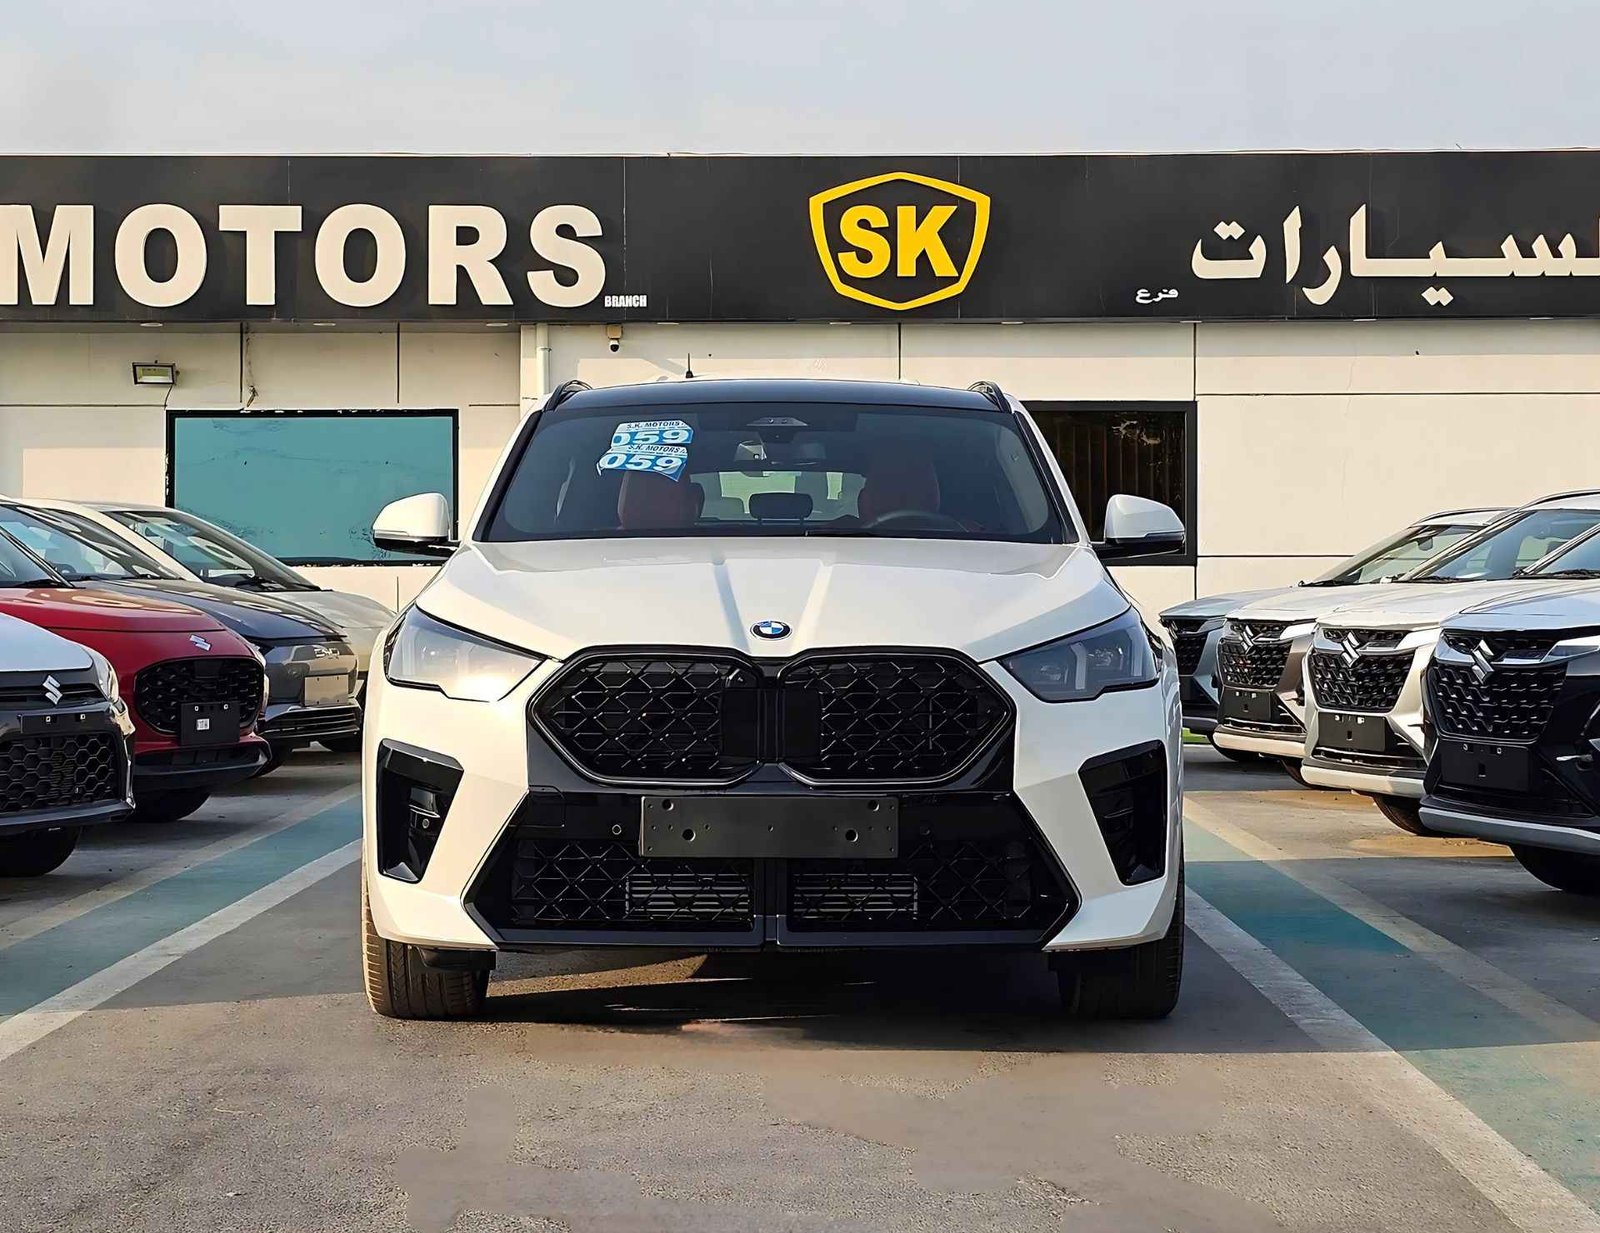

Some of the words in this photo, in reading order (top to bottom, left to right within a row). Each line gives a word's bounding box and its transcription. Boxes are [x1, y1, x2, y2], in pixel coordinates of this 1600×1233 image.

[837, 204, 959, 278] SK
[0, 203, 606, 307] MOTORS
[1191, 203, 1600, 306] سيارات
[604, 294, 648, 308] BRANCH
[1135, 288, 1179, 304] فرع
[611, 429, 690, 447] 059
[645, 445, 680, 453] MOTORS
[599, 453, 683, 475] 059
